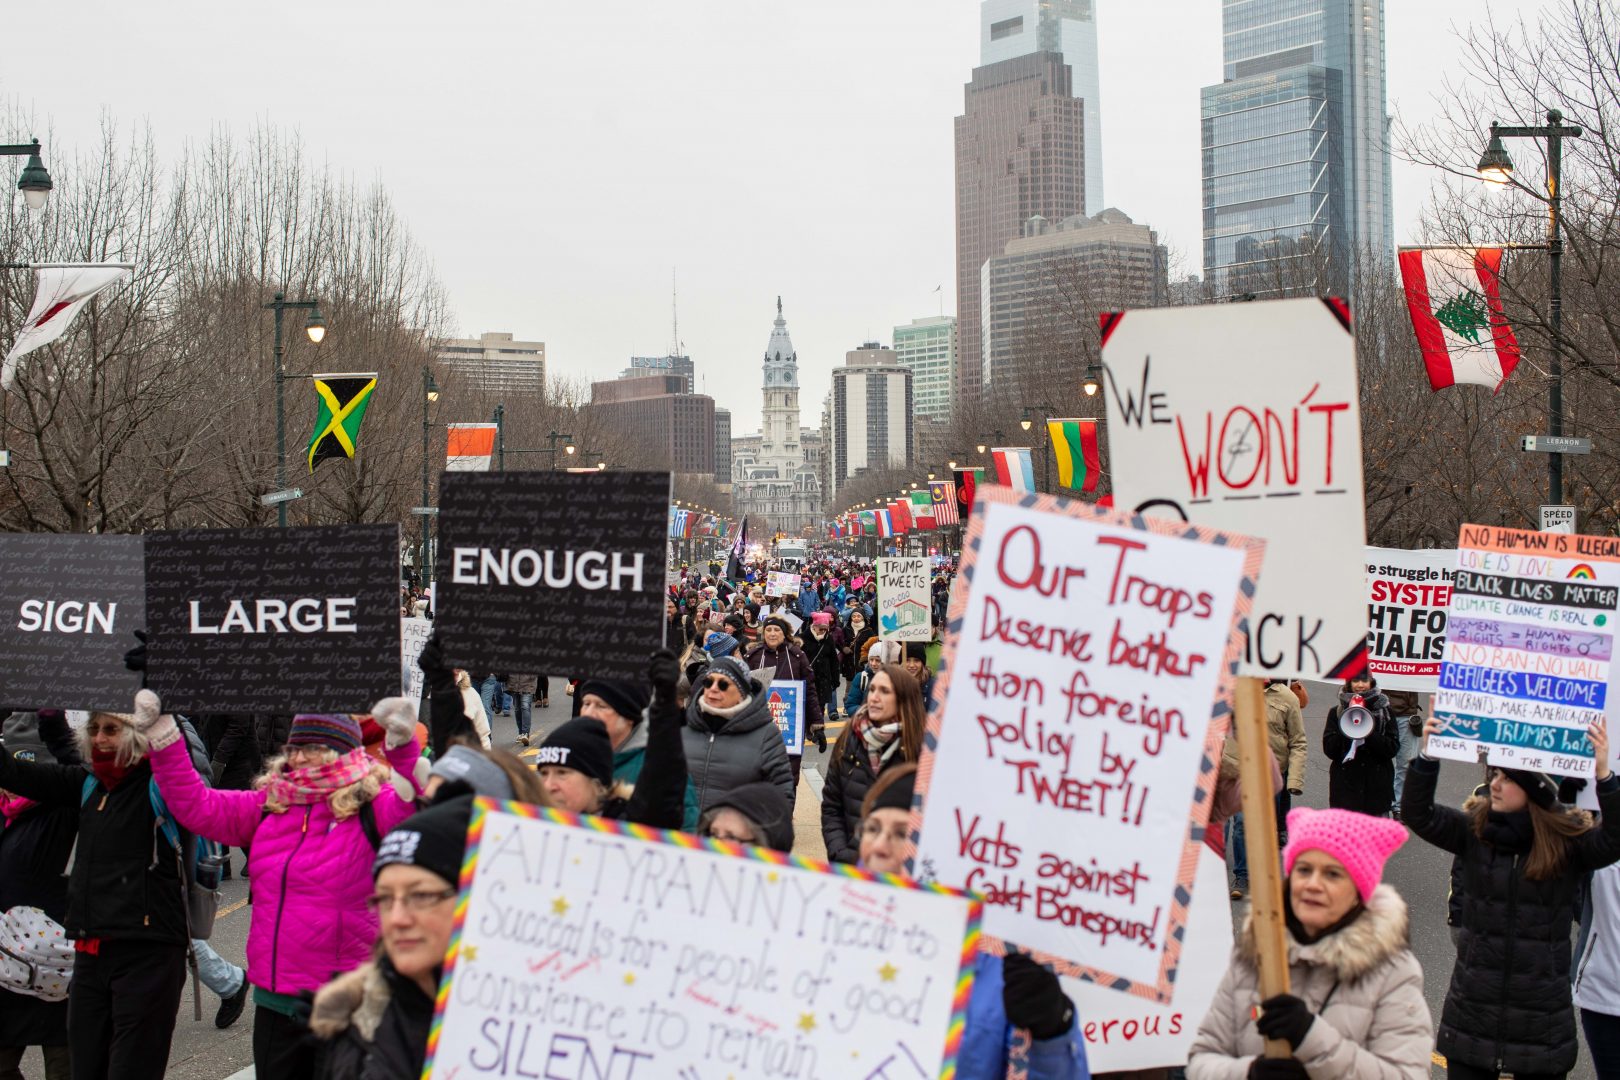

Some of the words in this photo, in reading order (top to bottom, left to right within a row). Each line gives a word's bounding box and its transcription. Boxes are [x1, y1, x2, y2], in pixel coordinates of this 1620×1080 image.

[633, 356, 673, 369] PSFS
[1102, 355, 1173, 430] WE
[1176, 382, 1349, 499] WON'T
[1546, 438, 1580, 446] LEBANON
[1543, 511, 1573, 519] SPEED
[1546, 520, 1570, 528] LIM
[206, 545, 261, 557] Plastics
[306, 541, 383, 560] Regulations
[1464, 529, 1490, 547] NO
[1496, 532, 1548, 550] HUMAN
[1555, 536, 1567, 553] IS
[1576, 538, 1620, 558] ILLEGAL
[452, 546, 645, 592] ENOUGH
[883, 560, 923, 573] TRUMP
[996, 524, 1086, 600] Our
[1096, 536, 1213, 629] Troops
[1378, 565, 1439, 582] struggle
[1460, 552, 1492, 571] LOVE
[1496, 554, 1510, 572] IS
[1516, 558, 1554, 577] LOVE
[880, 575, 925, 588] TWEETS
[1456, 571, 1503, 596] BLACK
[1510, 580, 1554, 601] LIVES
[1563, 585, 1616, 606] MATTER
[17, 599, 118, 635] SIGN
[189, 597, 357, 635] LARGE
[1368, 604, 1405, 632] HT
[1409, 608, 1446, 635] FO
[1454, 596, 1502, 615] CLIMATE
[1505, 603, 1544, 619] CHANGE
[1548, 608, 1559, 621] IS
[1562, 610, 1588, 626] REAL
[204, 637, 246, 651] Israel
[275, 636, 333, 650] Palestine
[404, 624, 430, 638] ARE
[980, 595, 1094, 664] Deserve
[1107, 617, 1206, 677] better
[1244, 612, 1322, 674] CK
[1458, 630, 1503, 647] RIGHTS
[1525, 628, 1571, 643] HUMAN
[226, 652, 263, 666] State
[1525, 641, 1570, 655] RIGHTS
[198, 668, 237, 682] Travel
[239, 669, 263, 681] Ban
[1369, 661, 1416, 673] OCIALISM
[1450, 644, 1487, 664] NO
[1567, 659, 1604, 682] WALL
[210, 684, 239, 696] Tree
[1444, 664, 1518, 696] REFUGEES
[1525, 675, 1599, 706] WELCOME
[194, 699, 277, 712] Destruction
[969, 656, 1044, 708] than
[1061, 670, 1189, 757] foreign
[1440, 714, 1480, 739] Love
[1494, 720, 1555, 750] TRUMPS
[535, 746, 571, 764] SIST
[977, 706, 1074, 775] policy
[1100, 731, 1137, 791] by
[1430, 739, 1467, 752] POWER
[1502, 747, 1515, 757] TO
[1521, 759, 1542, 770] THE
[1551, 757, 1592, 774] PEOPLE!
[1003, 758, 1149, 827] TWEET!!
[1036, 852, 1150, 907] against
[583, 838, 829, 938] TYRANNY
[902, 924, 941, 961] to
[619, 907, 668, 968] for
[668, 939, 781, 1012] people
[791, 950, 839, 1006] of
[828, 977, 932, 1035] good
[637, 1000, 689, 1051] to
[1084, 1011, 1184, 1045] erous
[467, 1016, 655, 1080] SILENT
